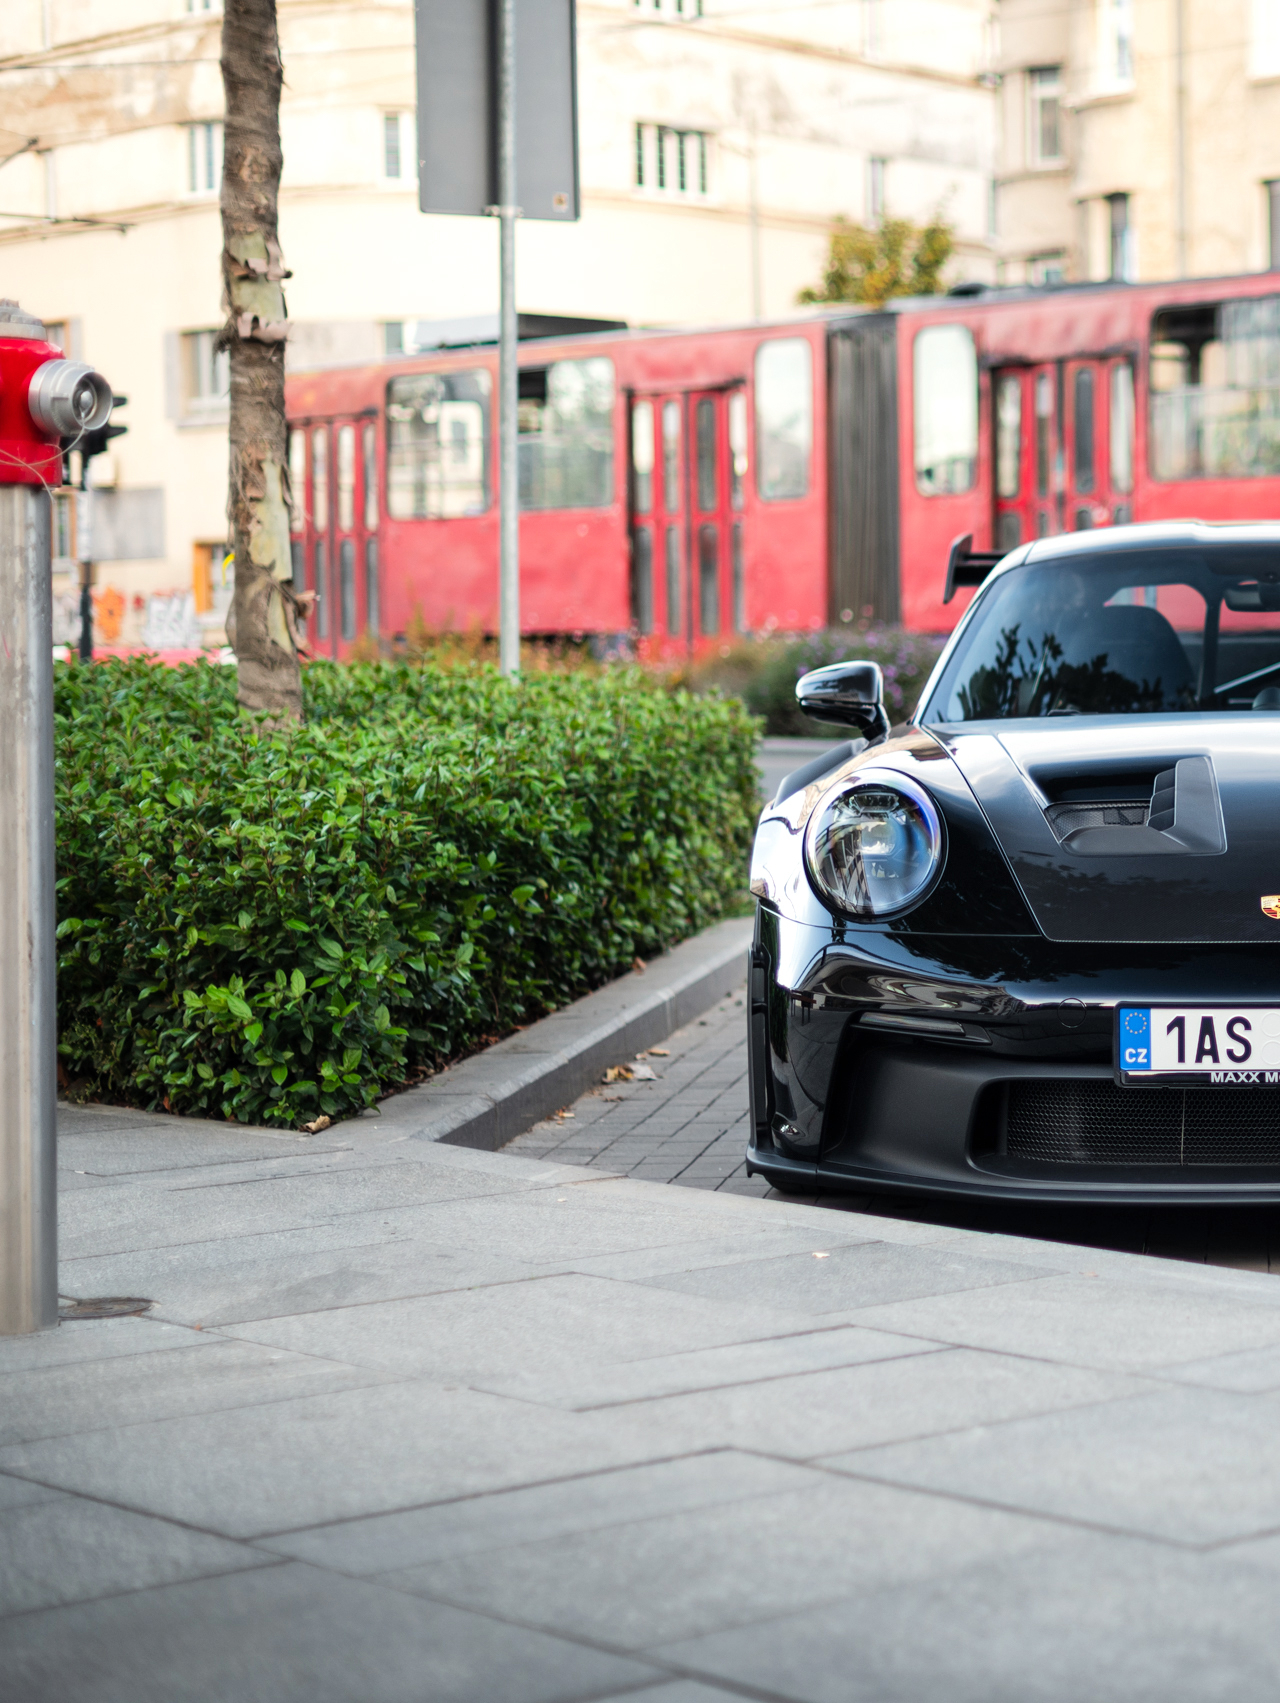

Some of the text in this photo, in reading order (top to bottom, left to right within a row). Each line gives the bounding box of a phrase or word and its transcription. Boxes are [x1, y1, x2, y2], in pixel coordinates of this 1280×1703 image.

[1166, 1015, 1253, 1064] 1AS
[1125, 1048, 1148, 1063] CZ
[1210, 1071, 1261, 1084] MAXX
